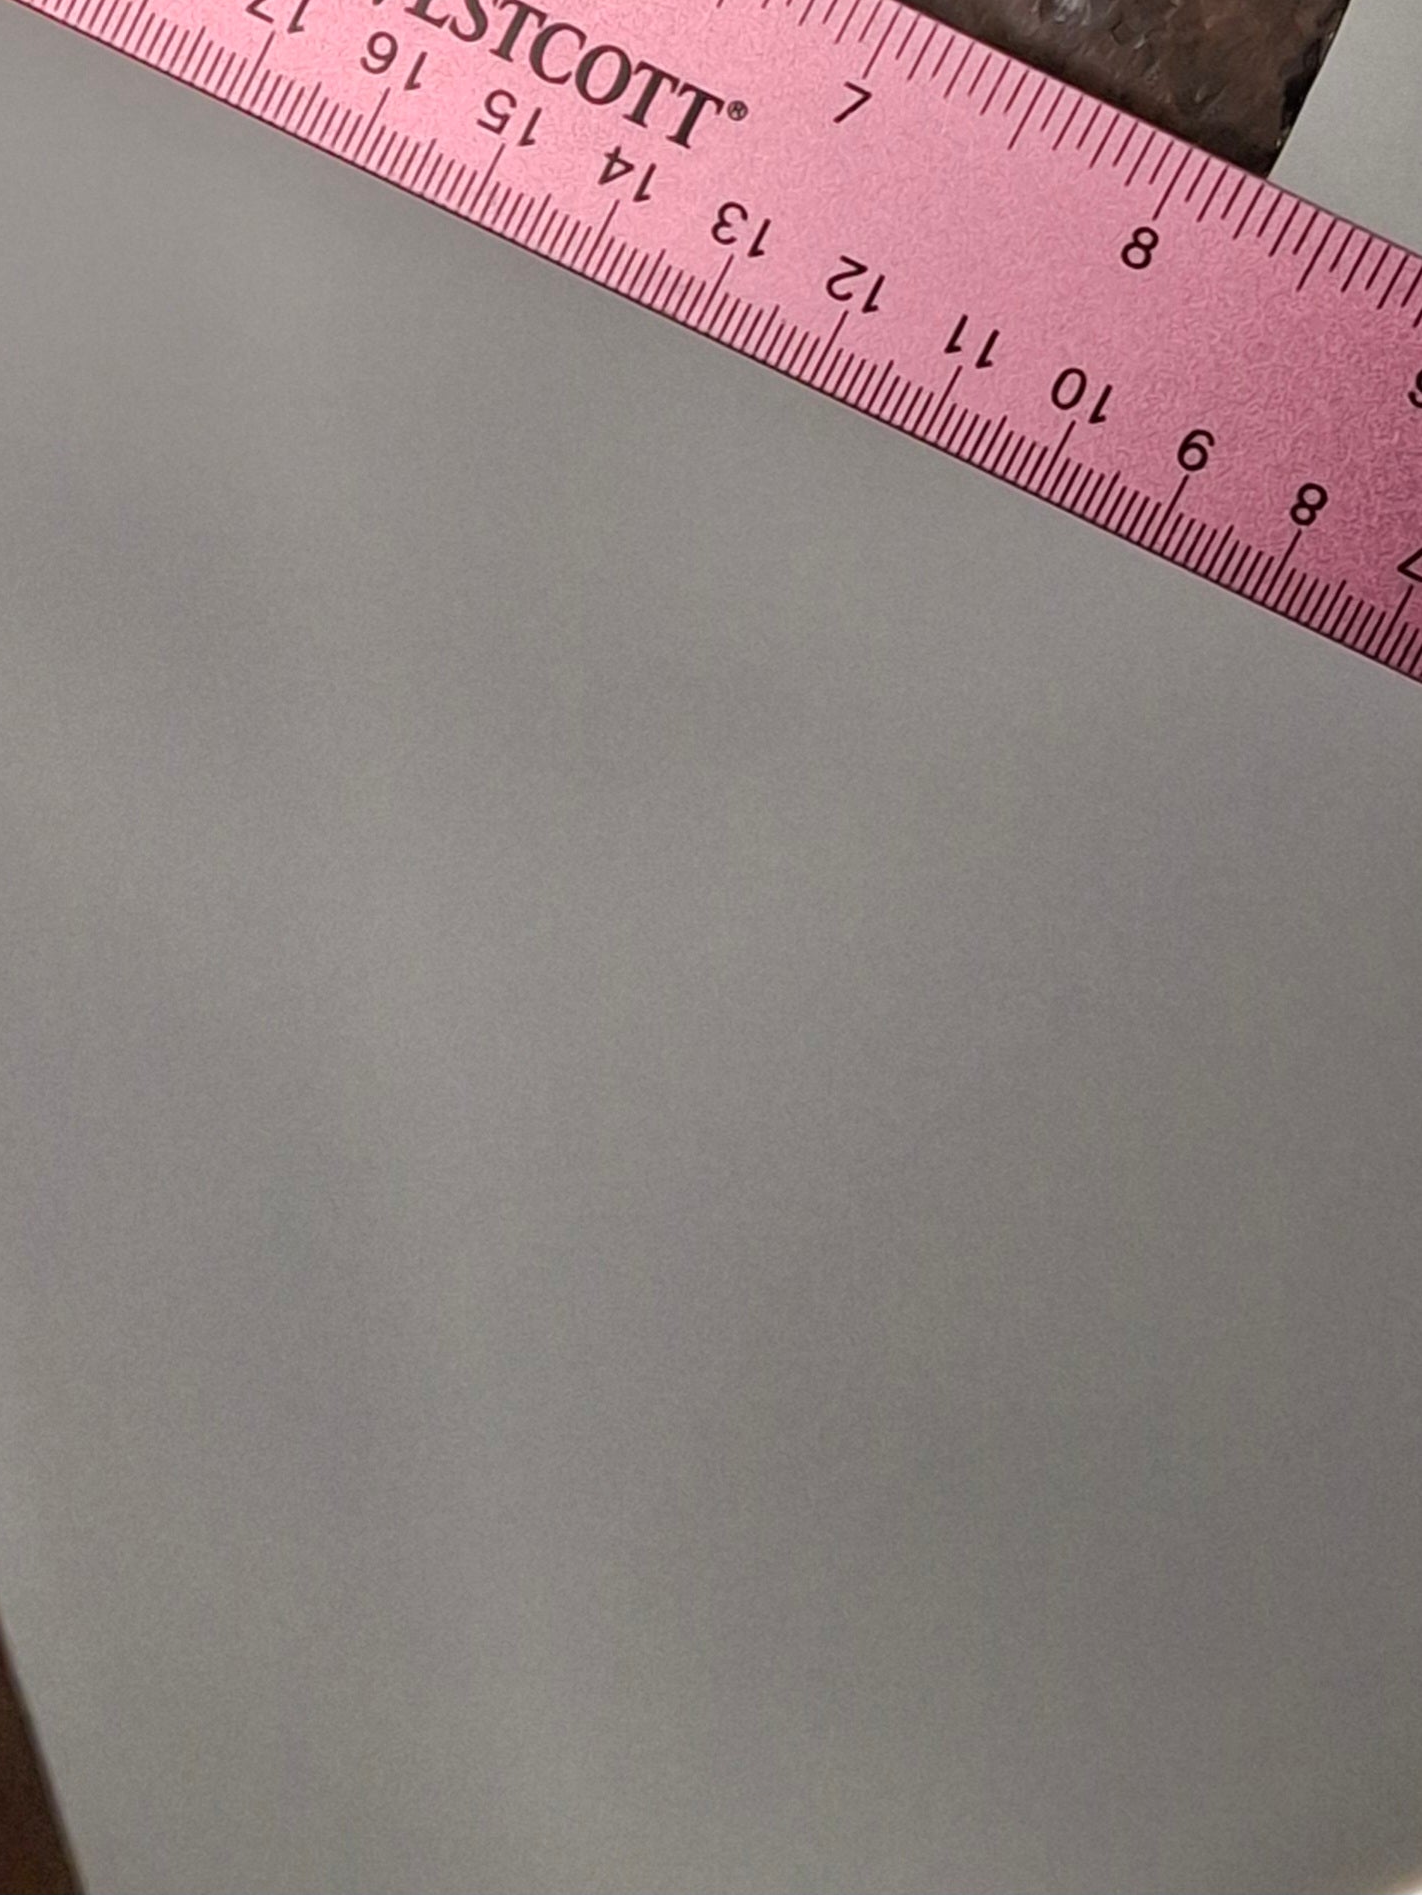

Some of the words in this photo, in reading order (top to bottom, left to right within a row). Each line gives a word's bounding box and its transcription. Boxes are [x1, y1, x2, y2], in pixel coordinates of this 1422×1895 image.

[359, 30, 428, 92] 16
[476, 88, 543, 147] 15
[597, 145, 657, 203] 14
[832, 80, 873, 124] 7
[1120, 226, 1160, 271] 8
[710, 201, 772, 259] 13
[825, 254, 886, 315] 12
[943, 313, 1001, 370] 11
[1050, 367, 1114, 425] 10
[1176, 428, 1216, 473] 9
[1288, 482, 1329, 527] 8
